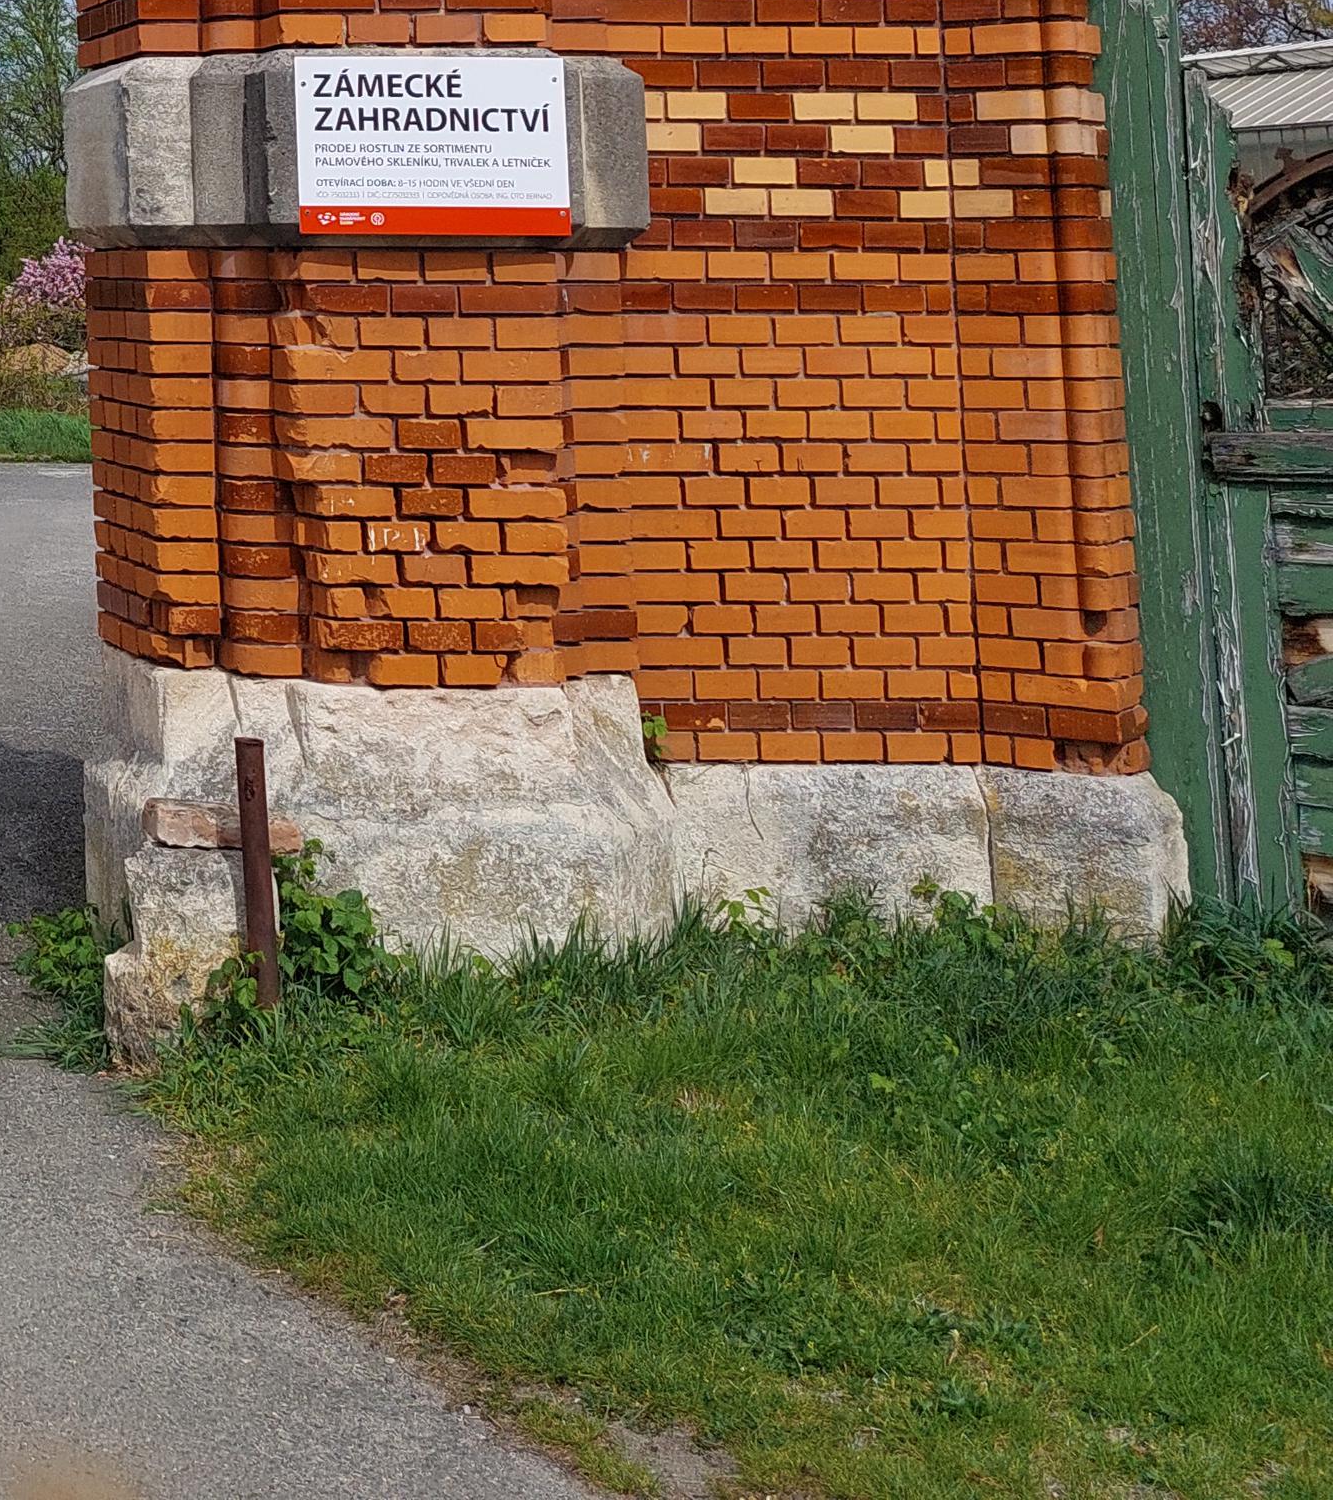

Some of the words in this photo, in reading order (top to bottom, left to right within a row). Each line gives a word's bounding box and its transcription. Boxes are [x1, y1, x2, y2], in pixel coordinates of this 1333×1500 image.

[313, 68, 463, 98] ZÁMECKÉ
[314, 103, 550, 132] ZAHRADNICTVÍ
[314, 144, 357, 154] PRODEJ
[359, 144, 405, 154] ROSTLIN
[407, 144, 421, 153] ZE
[423, 144, 492, 154] SORTIMENTU
[315, 156, 383, 167] PALMOVÉHO
[387, 155, 441, 168] SKLENÍKU,
[445, 158, 489, 167] TRVALEK
[492, 158, 499, 167] A
[502, 156, 552, 168] LETNIČEK
[316, 177, 365, 188] OTEVÍRACÍ
[367, 179, 396, 187] DOBA:
[419, 179, 449, 188] HODIN
[450, 179, 463, 188] VE
[464, 178, 494, 188] VŠEDNÍ
[497, 180, 515, 188] DEN
